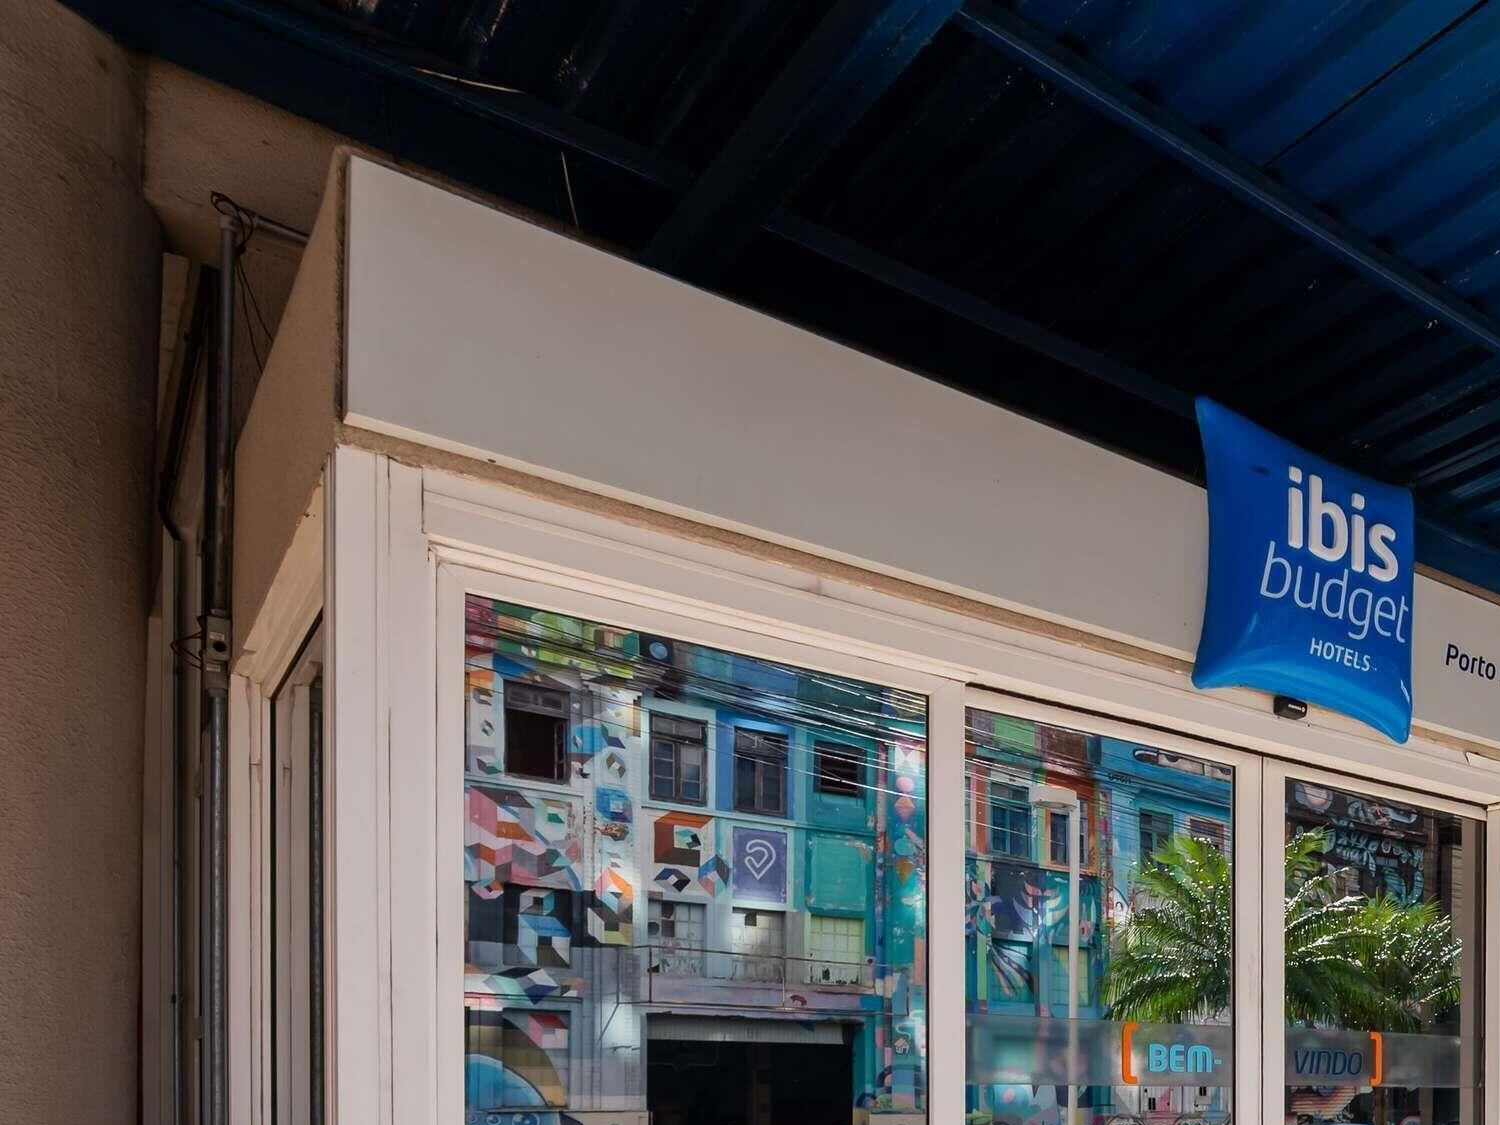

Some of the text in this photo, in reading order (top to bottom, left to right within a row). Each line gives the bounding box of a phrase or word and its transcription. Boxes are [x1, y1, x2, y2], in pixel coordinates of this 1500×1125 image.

[1288, 466, 1399, 582] ibis
[1259, 541, 1409, 643] budget
[1309, 637, 1371, 672] HOTELS
[1445, 643, 1496, 680] Porto
[1147, 1043, 1363, 1075] BEM- VINDO
